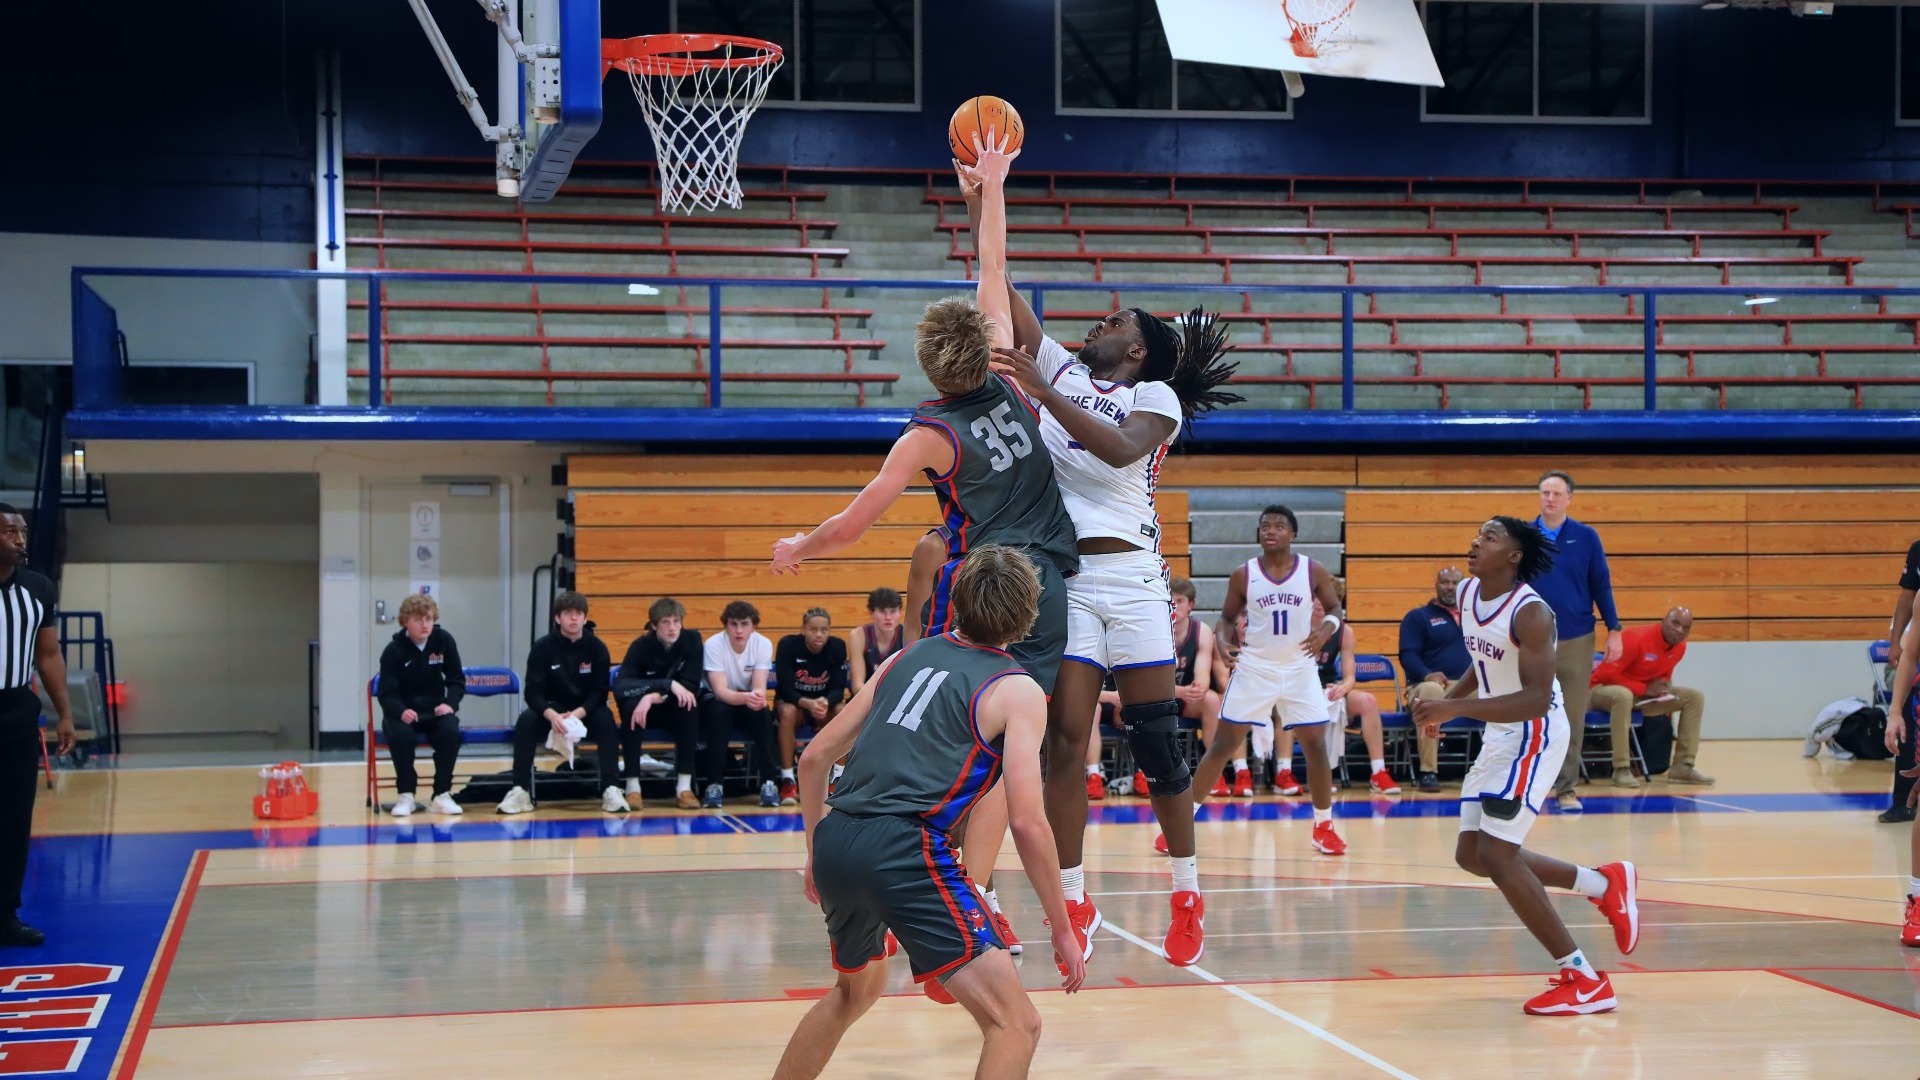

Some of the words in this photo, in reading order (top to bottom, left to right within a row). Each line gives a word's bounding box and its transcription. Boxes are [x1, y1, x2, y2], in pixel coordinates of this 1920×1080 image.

[971, 400, 1033, 472] 35
[1255, 594, 1277, 609] THE
[1278, 593, 1304, 607] VIEW
[1272, 610, 1288, 635] 11
[1463, 635, 1476, 652] HE
[1477, 637, 1505, 661] VIEW
[1478, 660, 1491, 693] 1
[886, 667, 950, 732] 11
[262, 801, 270, 815] G
